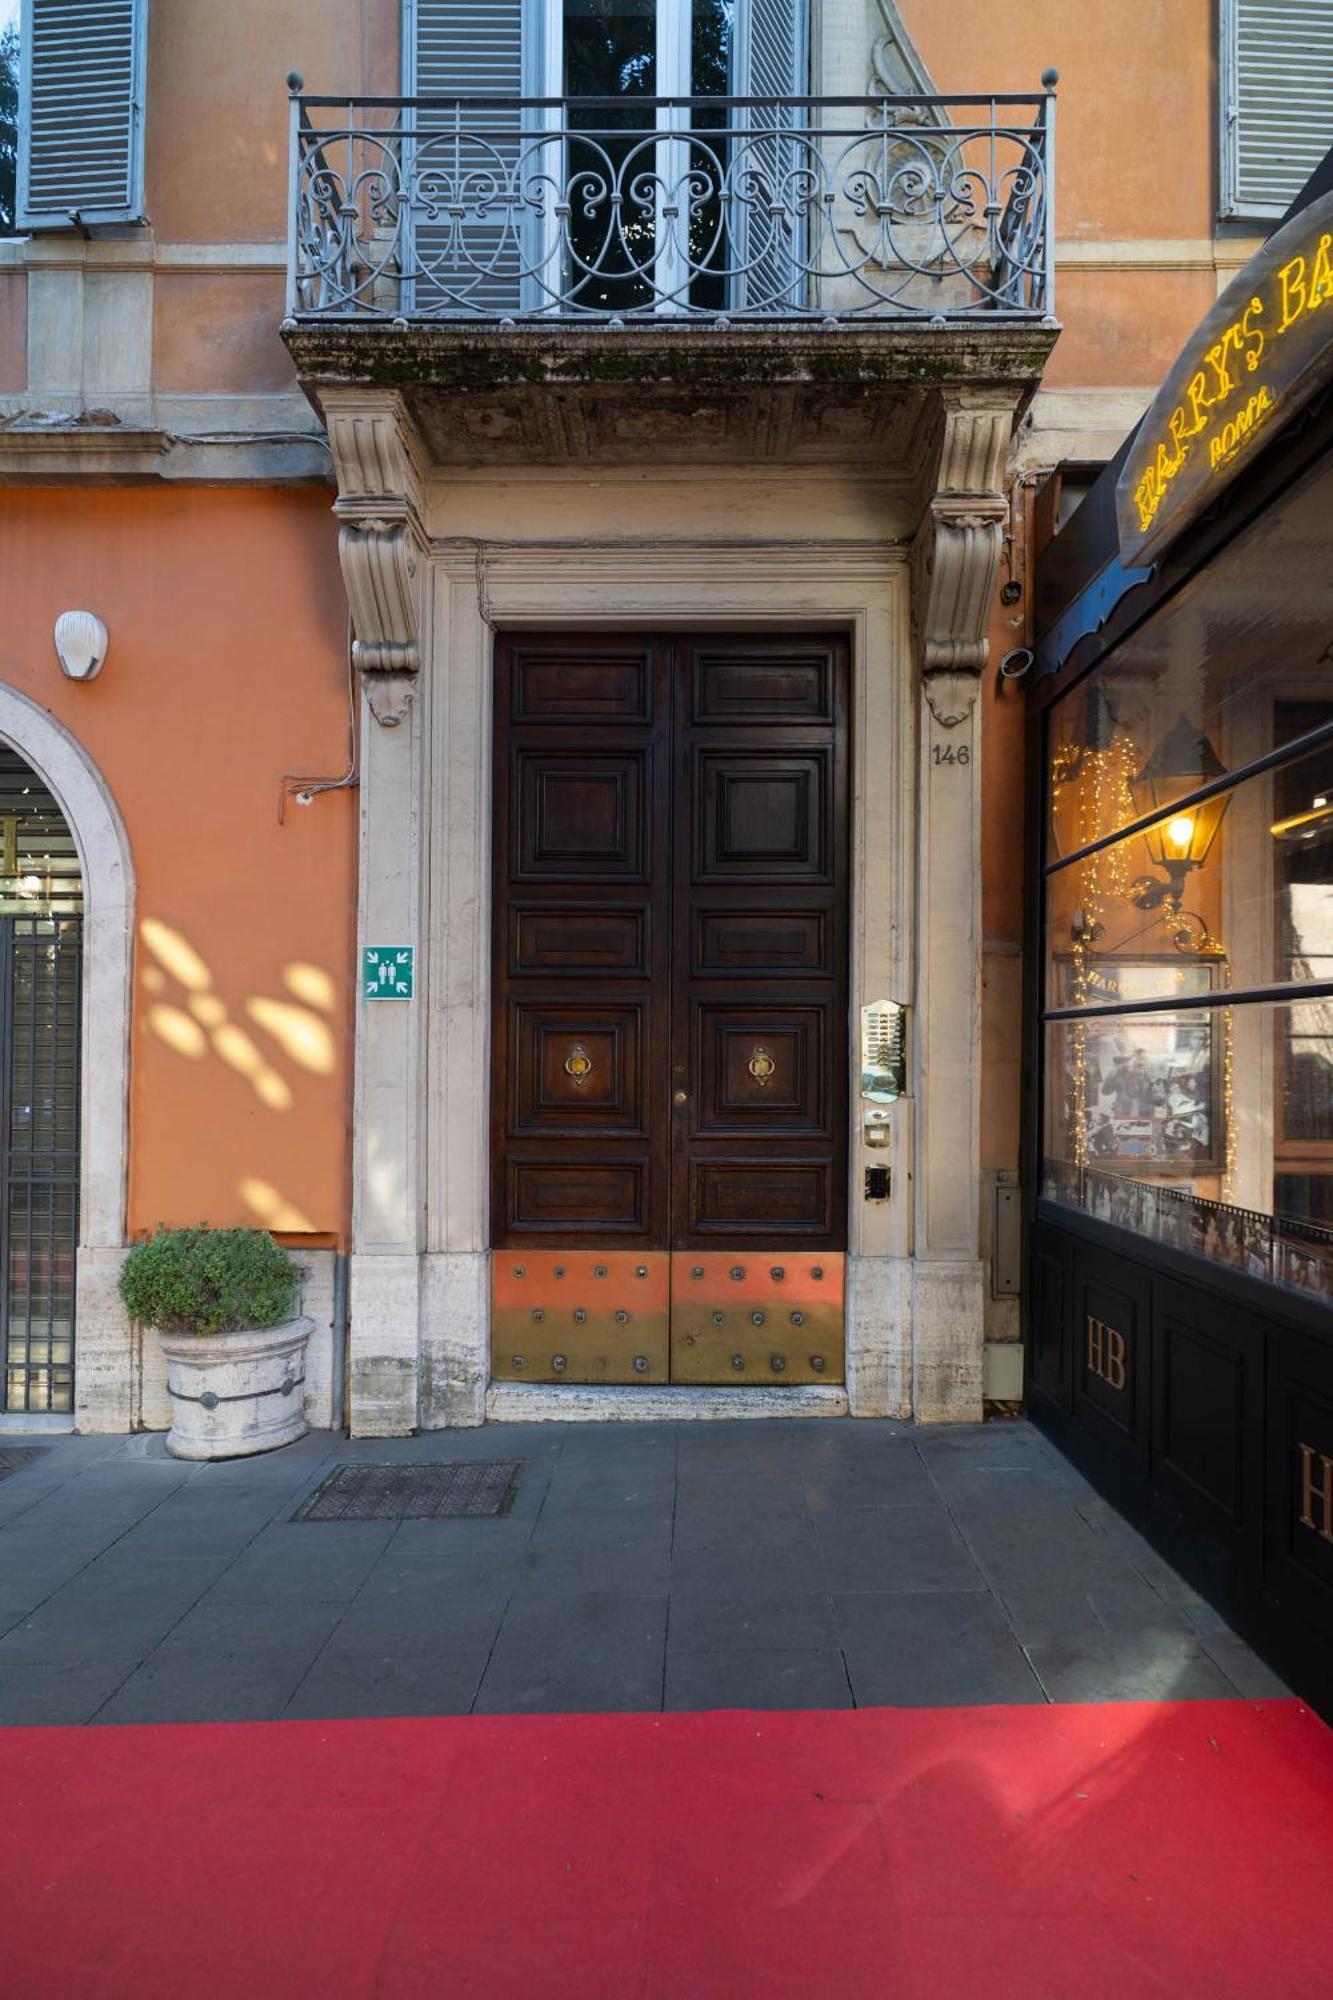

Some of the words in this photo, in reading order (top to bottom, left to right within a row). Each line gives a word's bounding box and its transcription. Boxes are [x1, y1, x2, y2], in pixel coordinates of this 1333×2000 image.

[1134, 297, 1264, 532] HARRY'S
[932, 744, 970, 766] 146
[1087, 1314, 1127, 1390] HB
